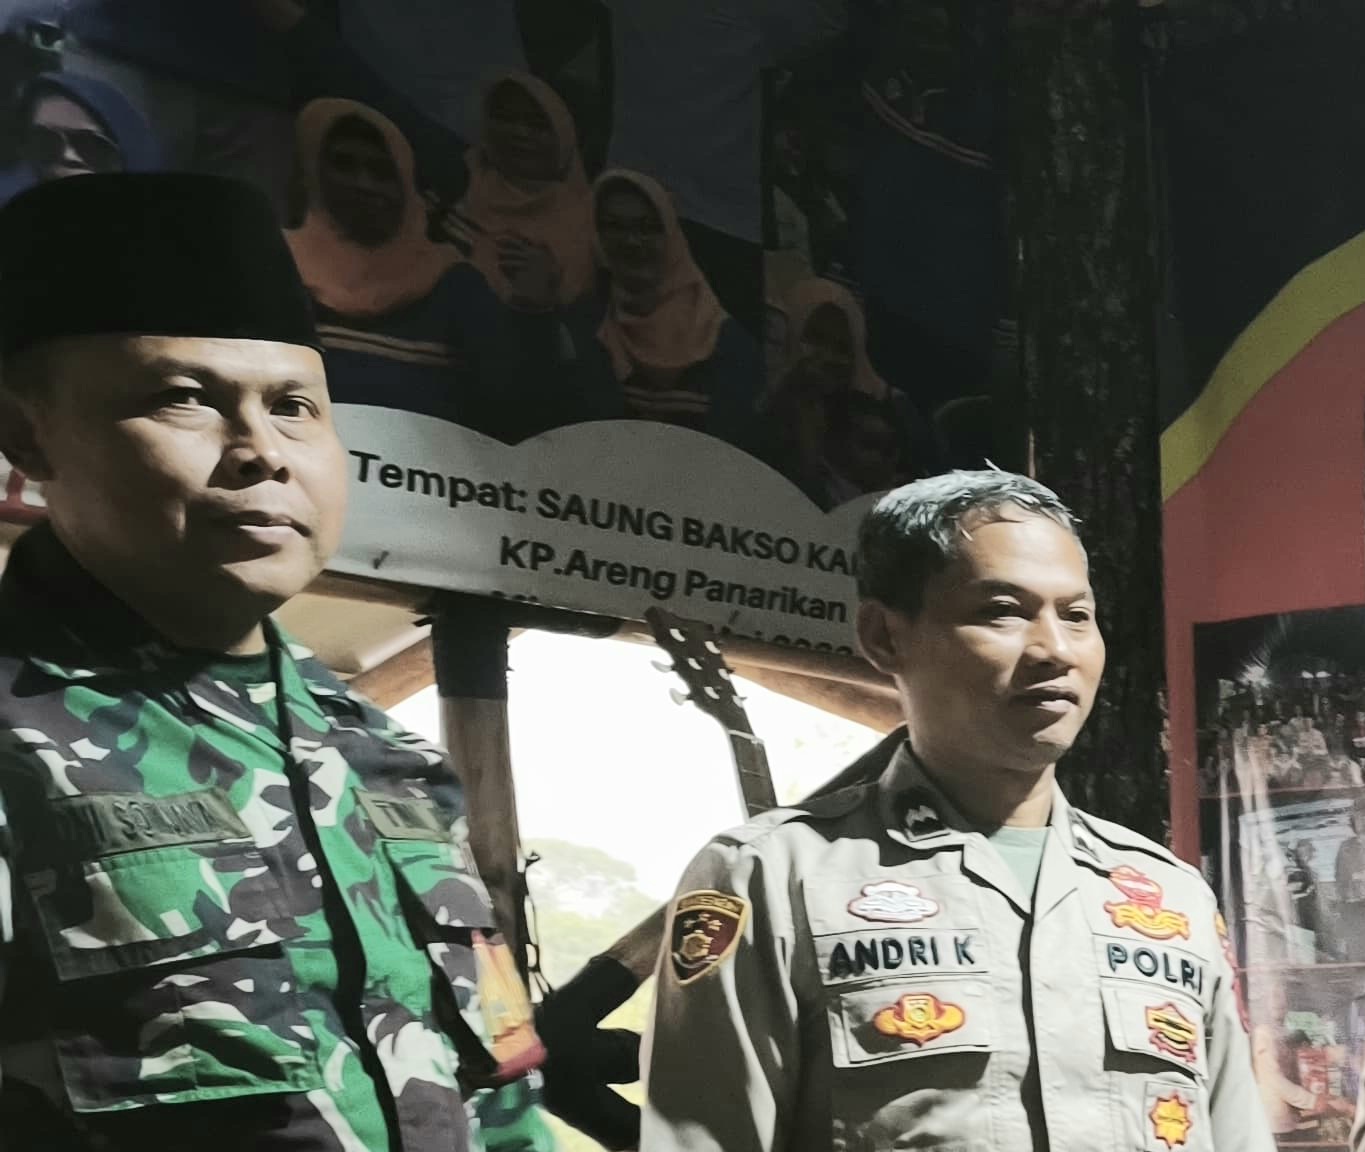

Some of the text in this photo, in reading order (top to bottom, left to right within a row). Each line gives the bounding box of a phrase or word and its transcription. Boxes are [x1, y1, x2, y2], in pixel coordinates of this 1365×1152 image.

[348, 449, 529, 515] Tempat:
[535, 488, 674, 541] SAUNG
[681, 517, 800, 565] BAKSO
[683, 568, 848, 624] Panarikan
[829, 935, 976, 980] ANDRI K
[1107, 942, 1203, 996] POLRI
